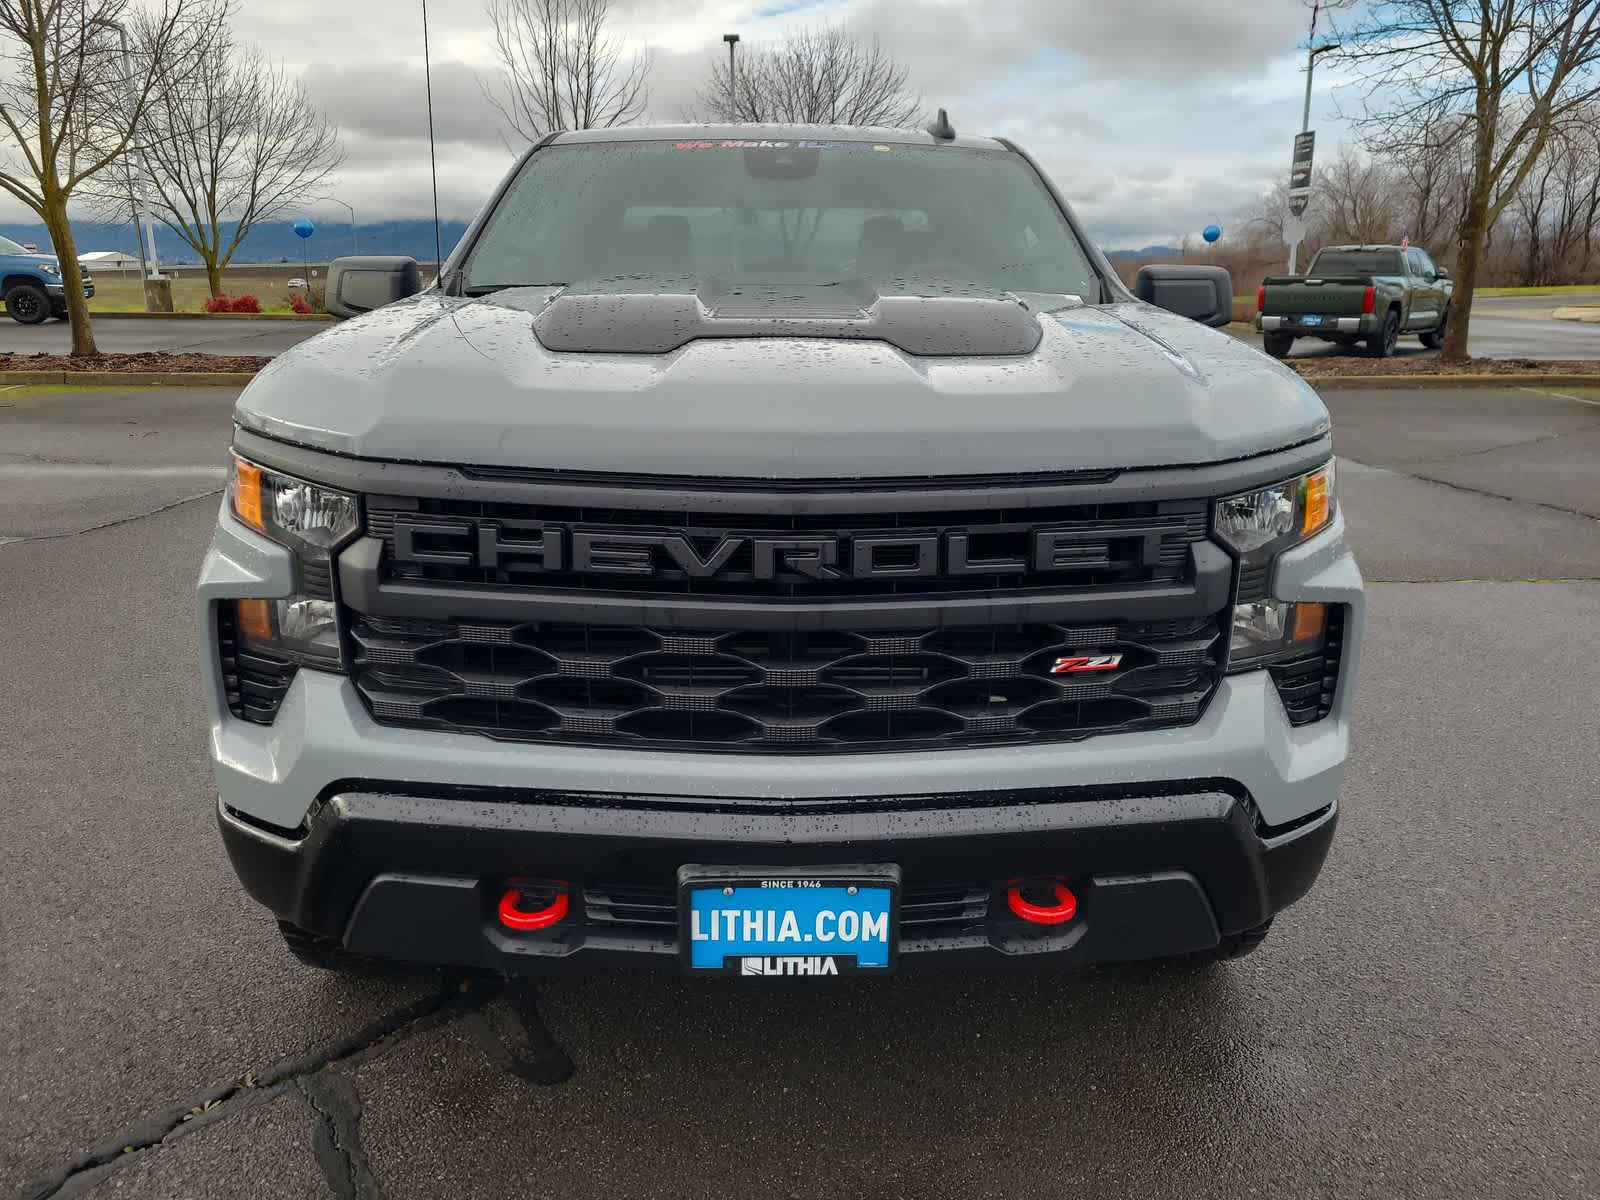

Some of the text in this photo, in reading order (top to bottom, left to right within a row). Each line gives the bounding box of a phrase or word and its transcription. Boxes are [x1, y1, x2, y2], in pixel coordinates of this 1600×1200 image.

[394, 513, 1190, 581] CHEVROLET
[1050, 655, 1124, 673] Z71
[761, 880, 822, 889] SINCE 1946
[691, 909, 889, 943] LITHIA.COM
[763, 956, 839, 976] LITHIA
